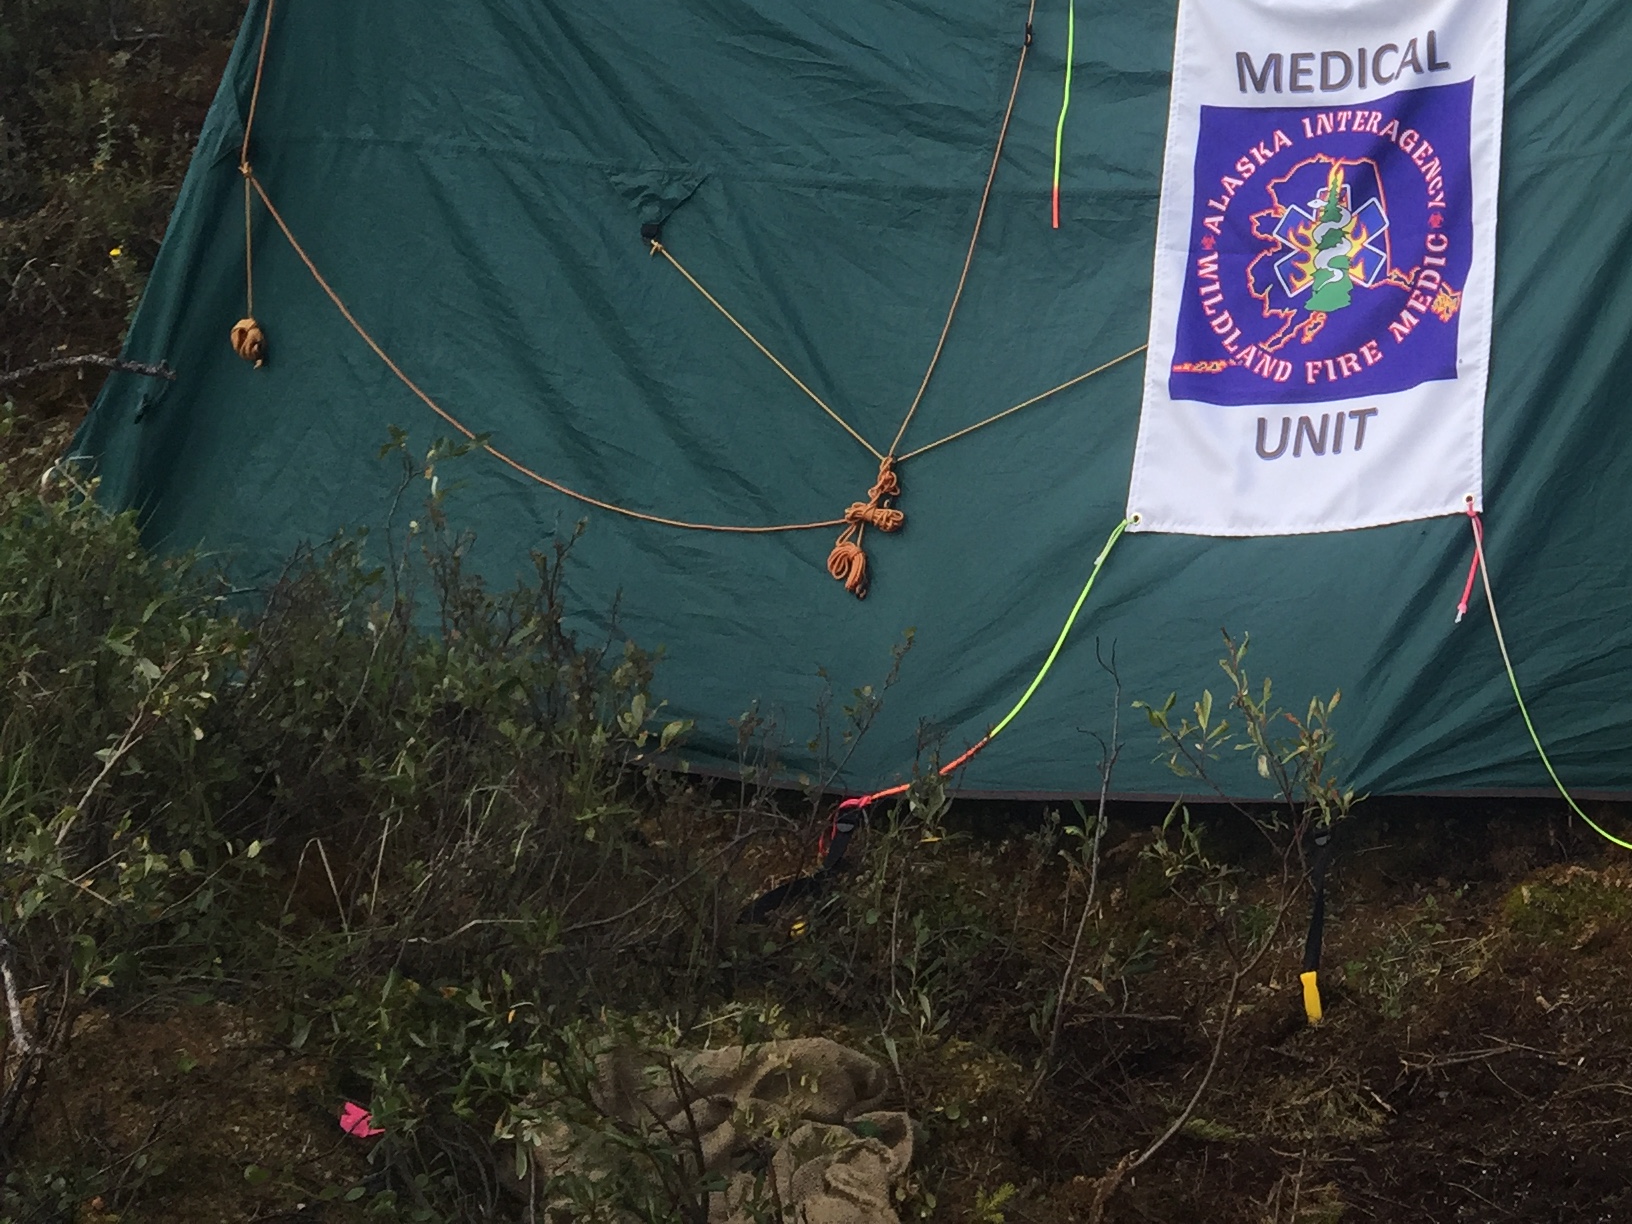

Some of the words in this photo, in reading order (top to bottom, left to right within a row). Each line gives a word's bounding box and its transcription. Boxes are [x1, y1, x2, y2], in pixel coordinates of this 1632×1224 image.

[1236, 30, 1451, 94] MEDICAL
[1204, 129, 1293, 235] ALASKA
[1302, 110, 1446, 209] INTERAGENCY
[1197, 251, 1293, 382] WILDLAND
[1305, 339, 1384, 383] FIRE
[1388, 233, 1448, 343] MEDIC
[1255, 407, 1378, 461] UNIT
